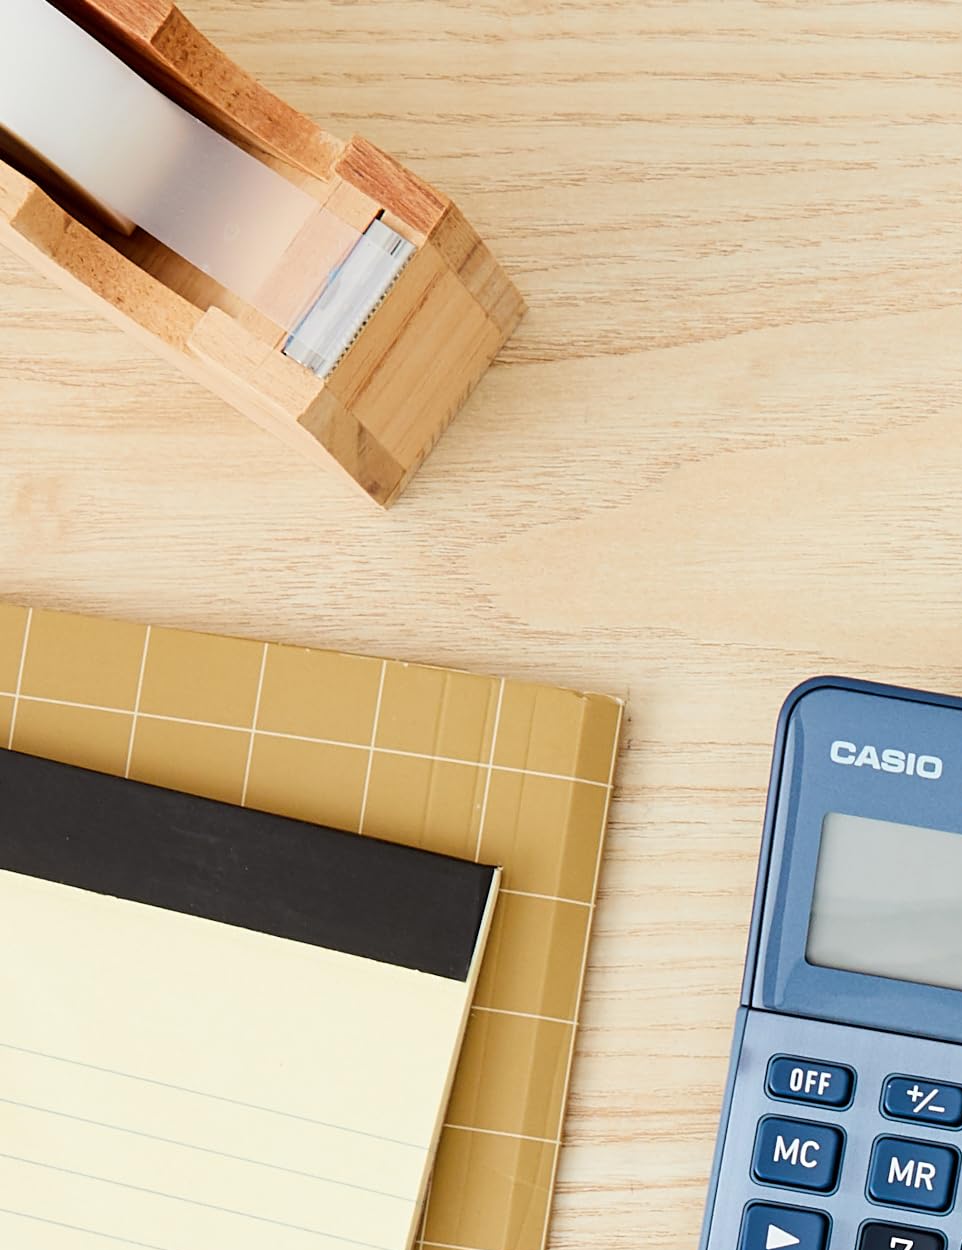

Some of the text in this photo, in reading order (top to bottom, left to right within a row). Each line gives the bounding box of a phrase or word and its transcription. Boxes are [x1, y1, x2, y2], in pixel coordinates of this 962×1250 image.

[830, 740, 943, 780] CASIO
[789, 1068, 832, 1095] OFF
[773, 1135, 820, 1168] MC
[887, 1156, 936, 1191] MR
